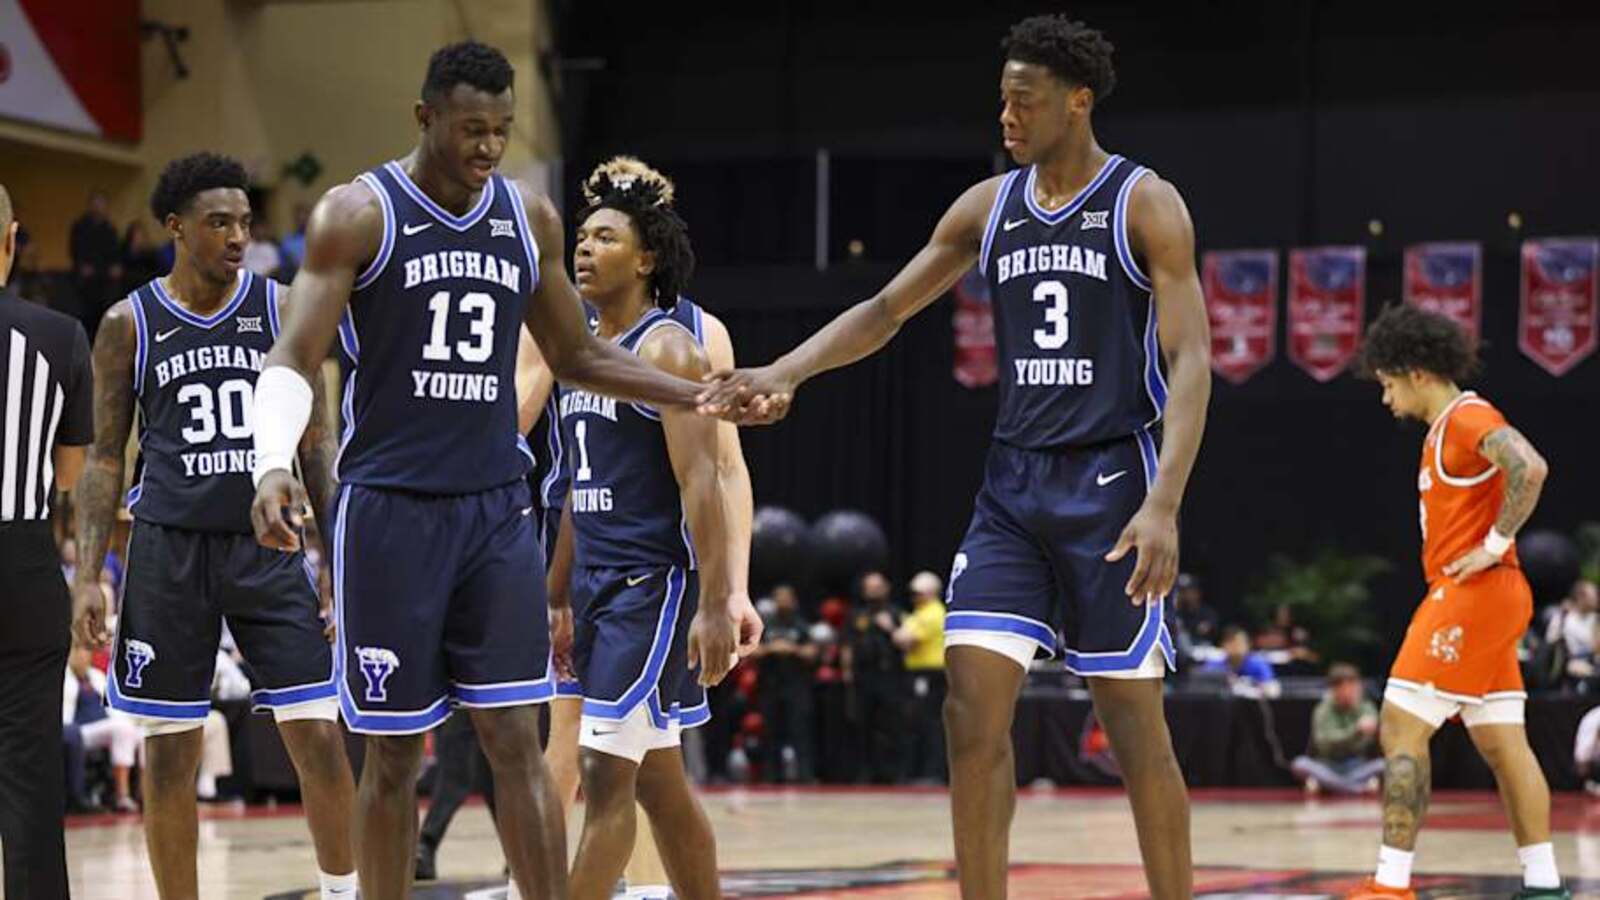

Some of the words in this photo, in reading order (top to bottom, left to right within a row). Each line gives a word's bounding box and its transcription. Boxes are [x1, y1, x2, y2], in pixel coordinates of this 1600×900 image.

[404, 251, 520, 293] BRIGHAM
[998, 245, 1108, 284] BRIGHAM
[422, 291, 496, 362] 13
[1033, 281, 1069, 350] 3
[412, 369, 498, 402] YOUNG
[1015, 359, 1093, 386] YOUNG
[177, 380, 255, 444] 30
[575, 420, 592, 481] 1
